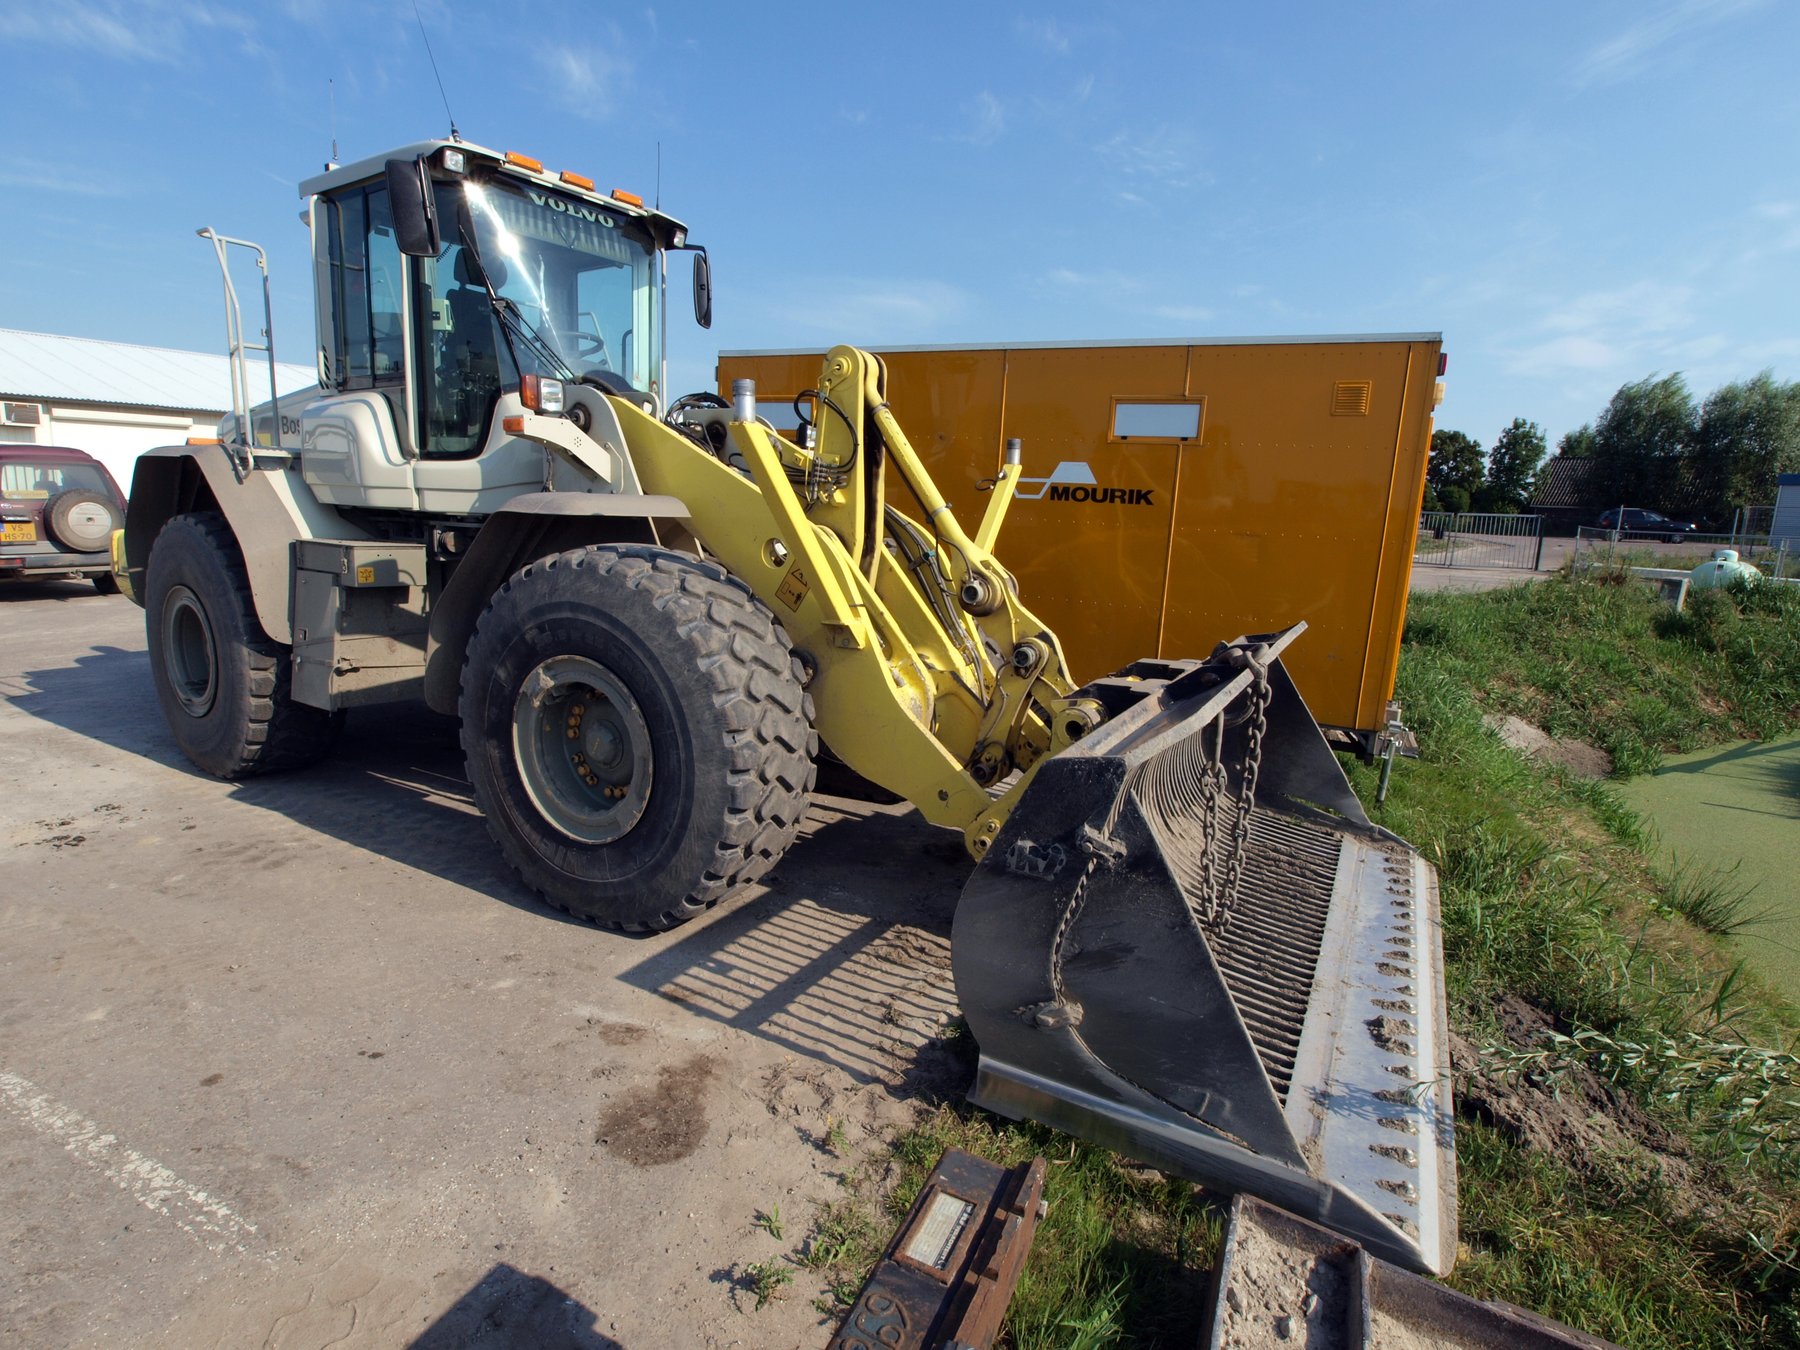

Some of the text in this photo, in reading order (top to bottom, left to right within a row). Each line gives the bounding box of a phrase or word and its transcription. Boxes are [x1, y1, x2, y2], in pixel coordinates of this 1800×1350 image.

[528, 191, 615, 228] VOLVO
[1050, 485, 1155, 506] MOURIK
[11, 524, 24, 532] VS
